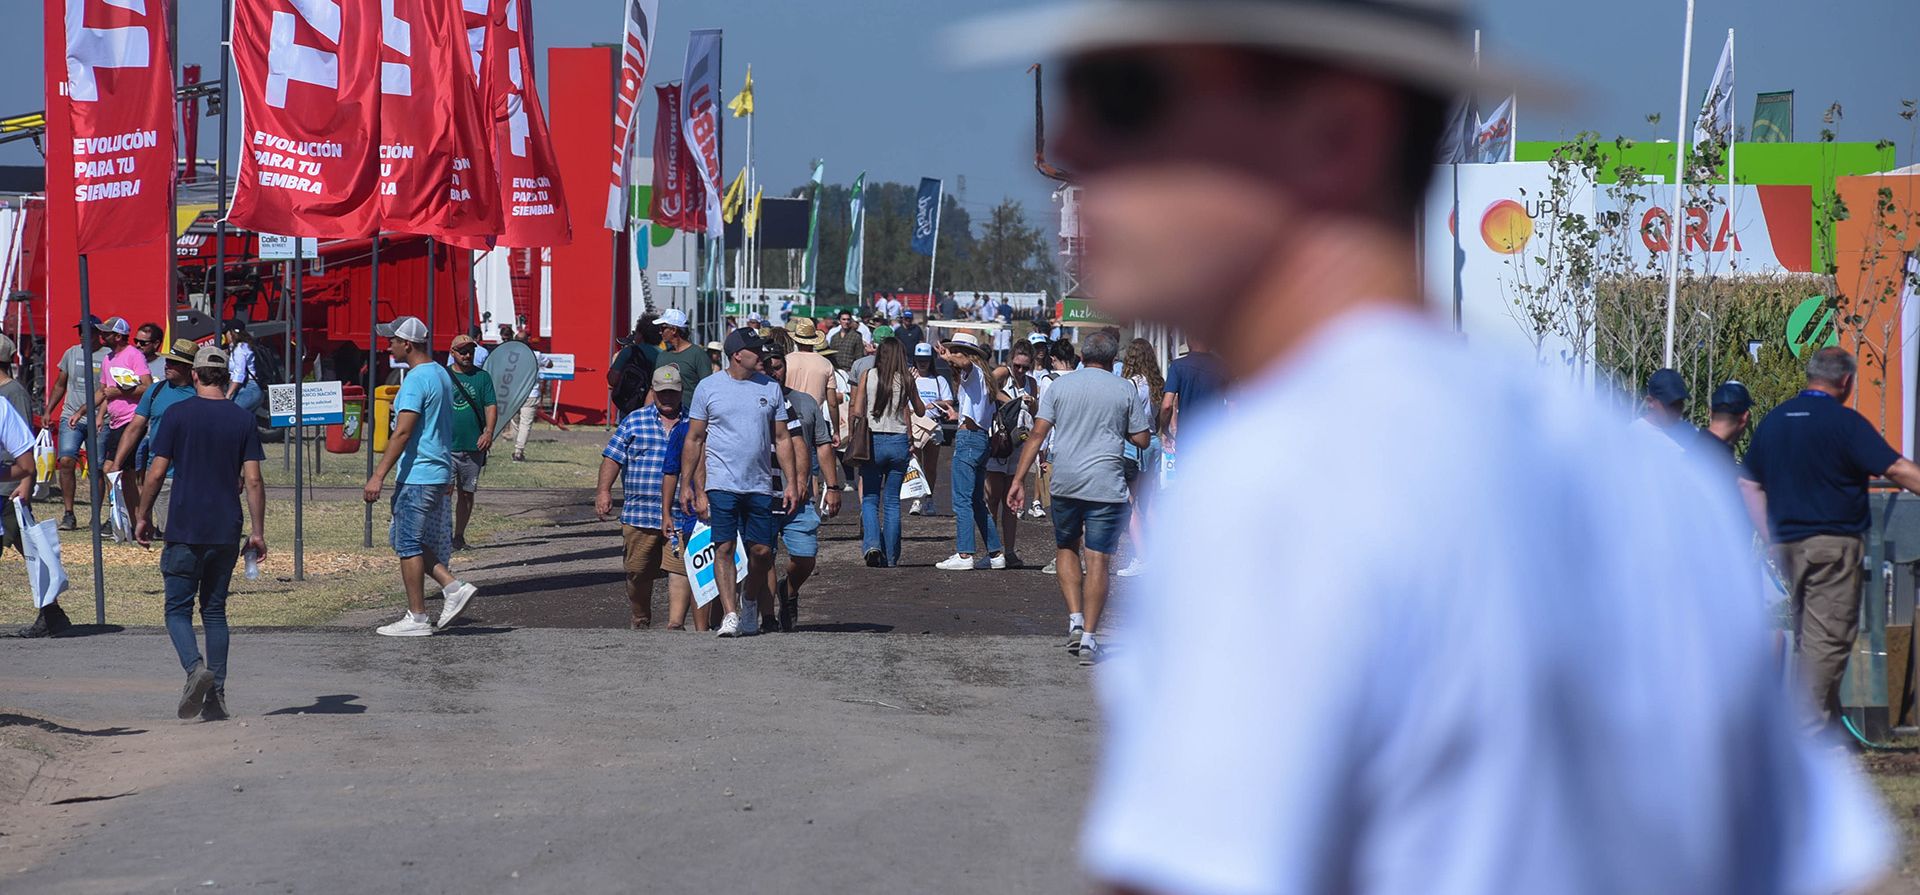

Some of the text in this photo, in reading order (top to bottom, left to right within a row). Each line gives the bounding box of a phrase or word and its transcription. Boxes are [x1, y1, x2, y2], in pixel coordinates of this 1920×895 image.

[73, 129, 157, 155] EVOLUCIÓN
[253, 130, 342, 157] EVOLUCIÓN
[74, 156, 135, 178] PARA TU
[298, 160, 322, 176] TU
[380, 163, 392, 177] U
[258, 171, 323, 195] IEMBRA
[538, 190, 549, 201] TU
[512, 203, 554, 216] SIEMBRA
[1526, 199, 1567, 219] UPL
